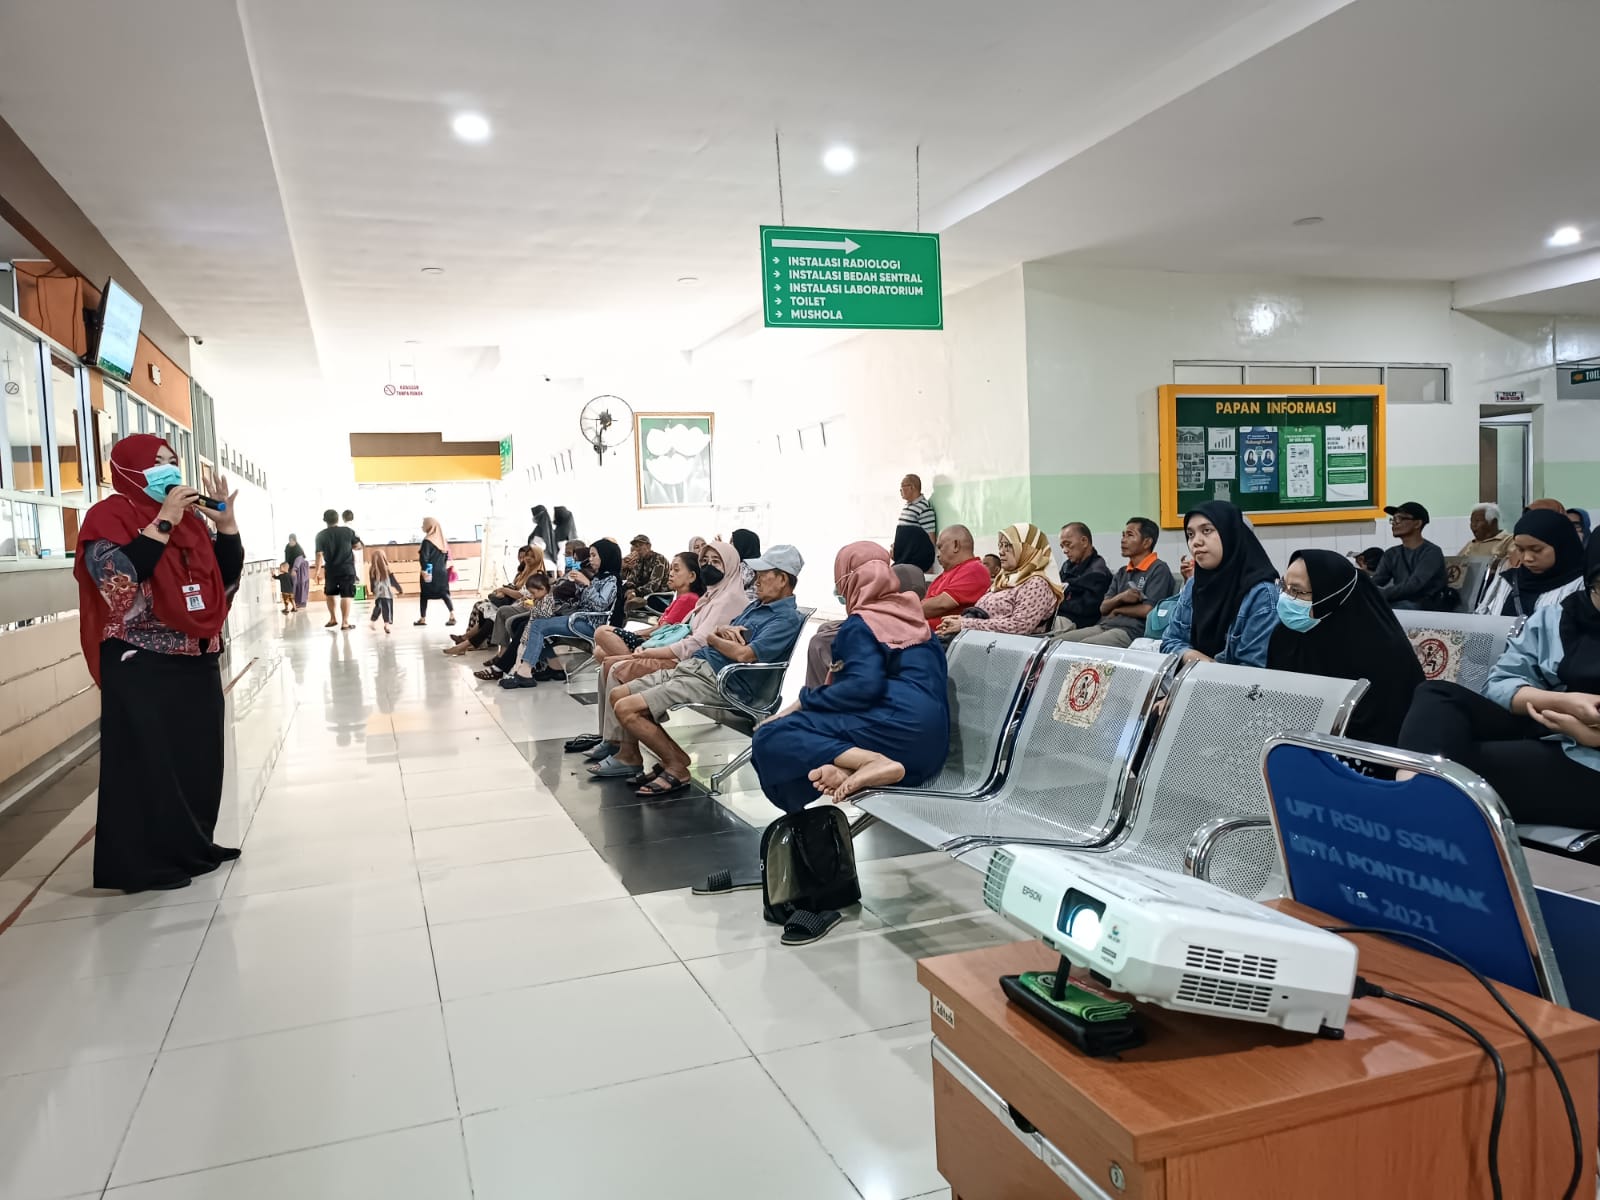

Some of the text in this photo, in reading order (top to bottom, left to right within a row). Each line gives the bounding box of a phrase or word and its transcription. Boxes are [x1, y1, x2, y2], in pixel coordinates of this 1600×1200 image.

[788, 256, 900, 270] INSTALASI RADIOLOGI
[789, 270, 923, 283] INSTALASI BEDAH SENTRAL
[790, 283, 924, 296] INSTALASI LABORATORIUM
[790, 296, 826, 306] TOILET
[791, 309, 843, 320] MUSHOLA
[1215, 402, 1337, 414] PAPAN INFORMASI
[1286, 797, 1469, 865] UPT RSUD SSMA
[1347, 851, 1491, 914] PONTIANAK
[1022, 885, 1042, 903] EPSON
[1381, 899, 1440, 934] 2021
